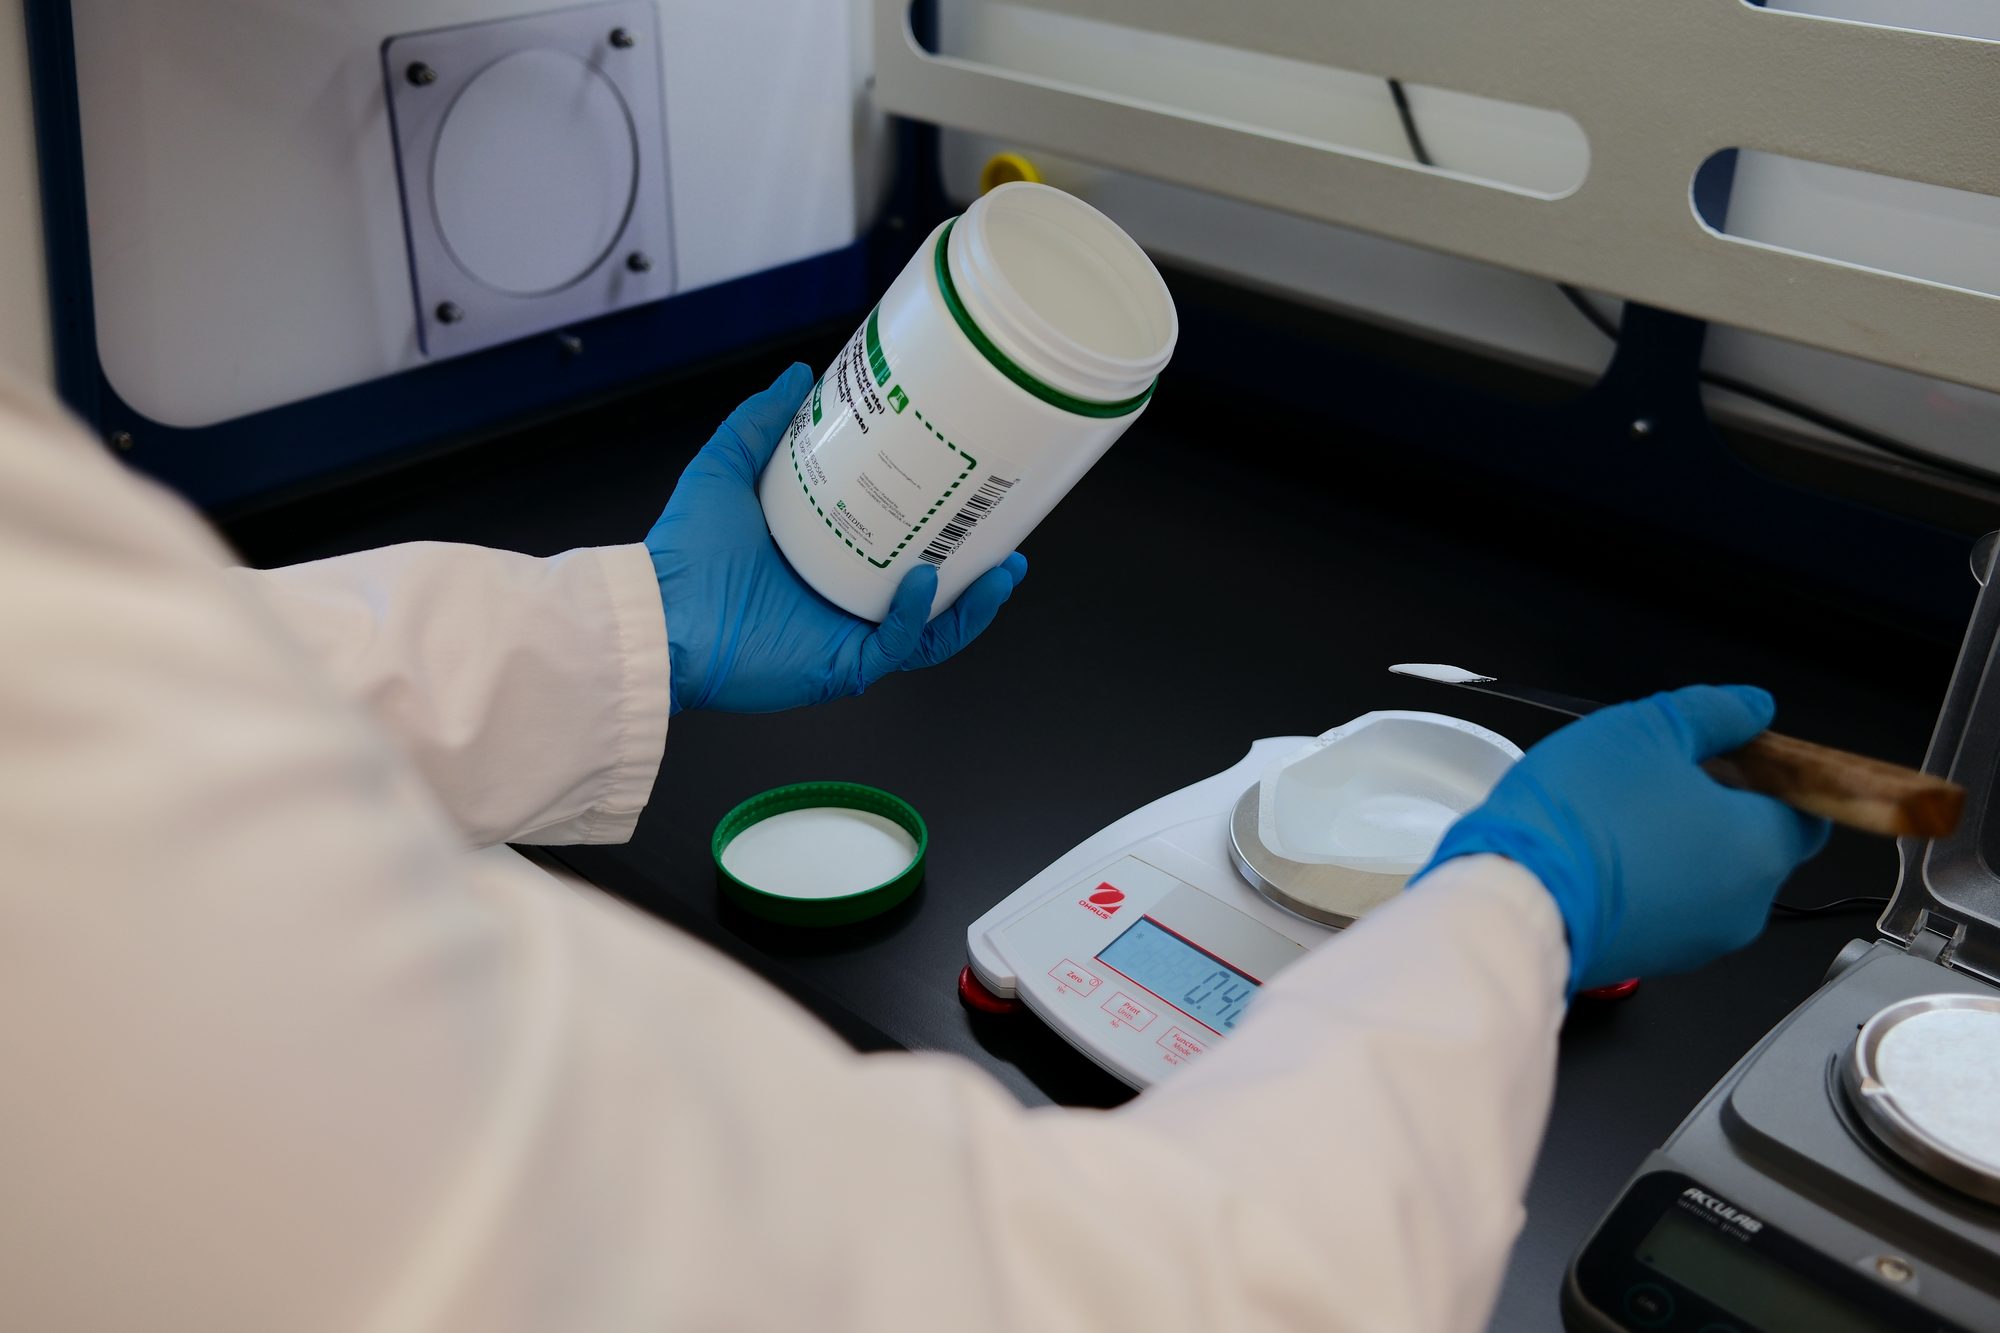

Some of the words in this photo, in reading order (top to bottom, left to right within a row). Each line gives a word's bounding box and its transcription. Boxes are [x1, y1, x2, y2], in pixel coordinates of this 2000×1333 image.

[842, 508, 872, 538] MEDISCA
[1078, 899, 1110, 920] OHAUS
[1066, 970, 1083, 984] Zero
[1117, 1007, 1133, 1021] Units
[1122, 1001, 1141, 1016] Print
[1172, 1042, 1191, 1057] Mode
[1682, 1187, 1764, 1233] ACCULAB
